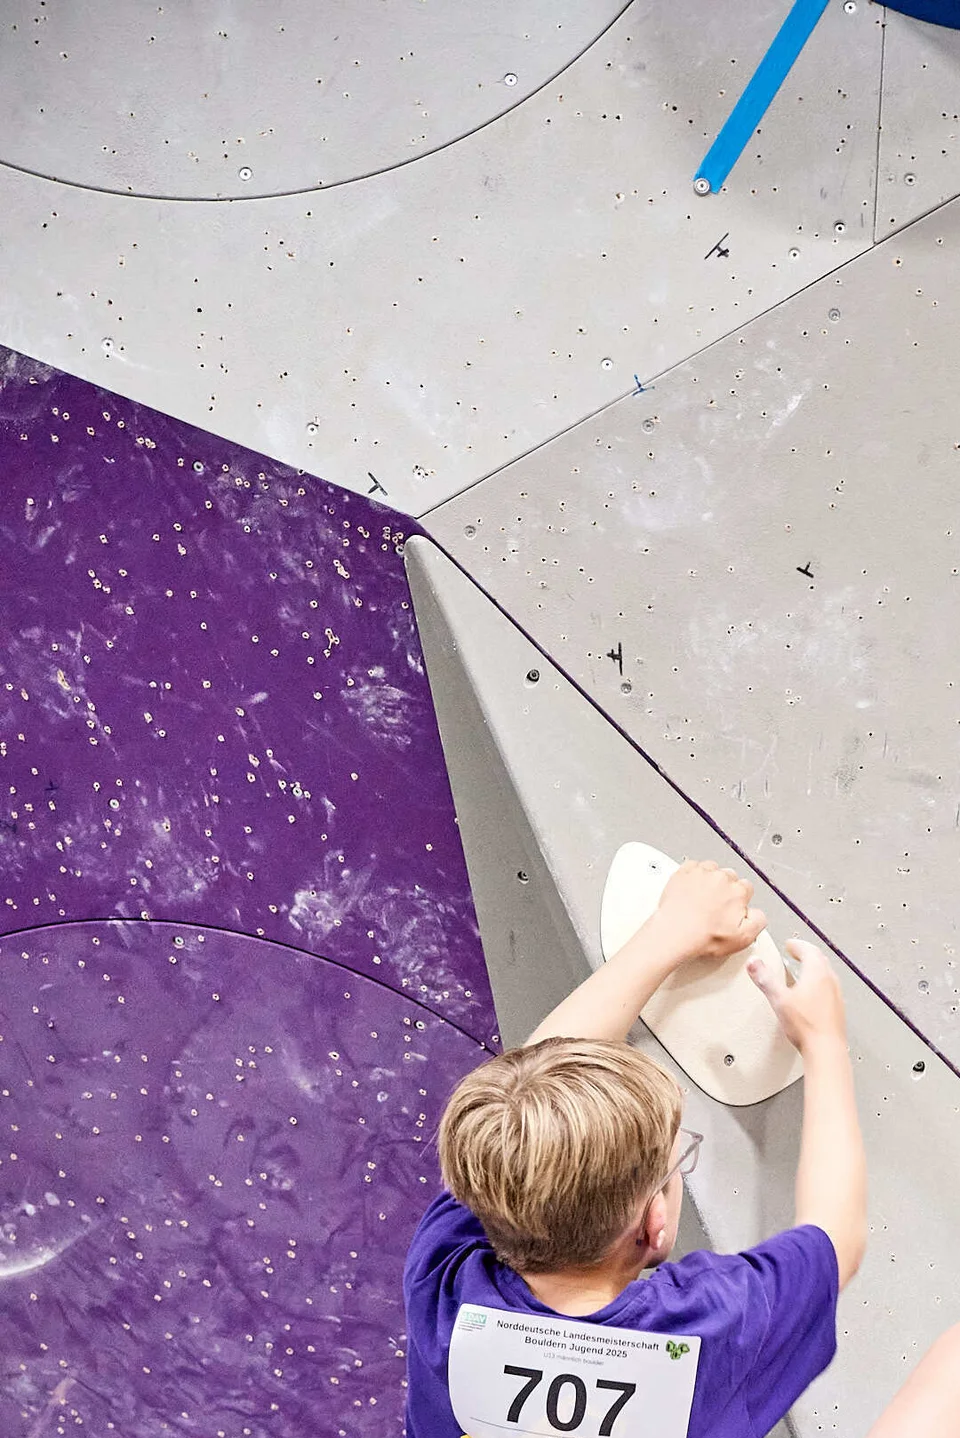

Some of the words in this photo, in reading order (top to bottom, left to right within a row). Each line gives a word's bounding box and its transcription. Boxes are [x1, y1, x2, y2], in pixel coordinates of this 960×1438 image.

[496, 1319, 562, 1338] Norddeutsche
[563, 1330, 660, 1351] Landesmeisterschaft
[524, 1335, 567, 1350] Bouldern
[569, 1341, 604, 1356] Jugend
[605, 1347, 628, 1359] 2025
[503, 1364, 637, 1438] 707
